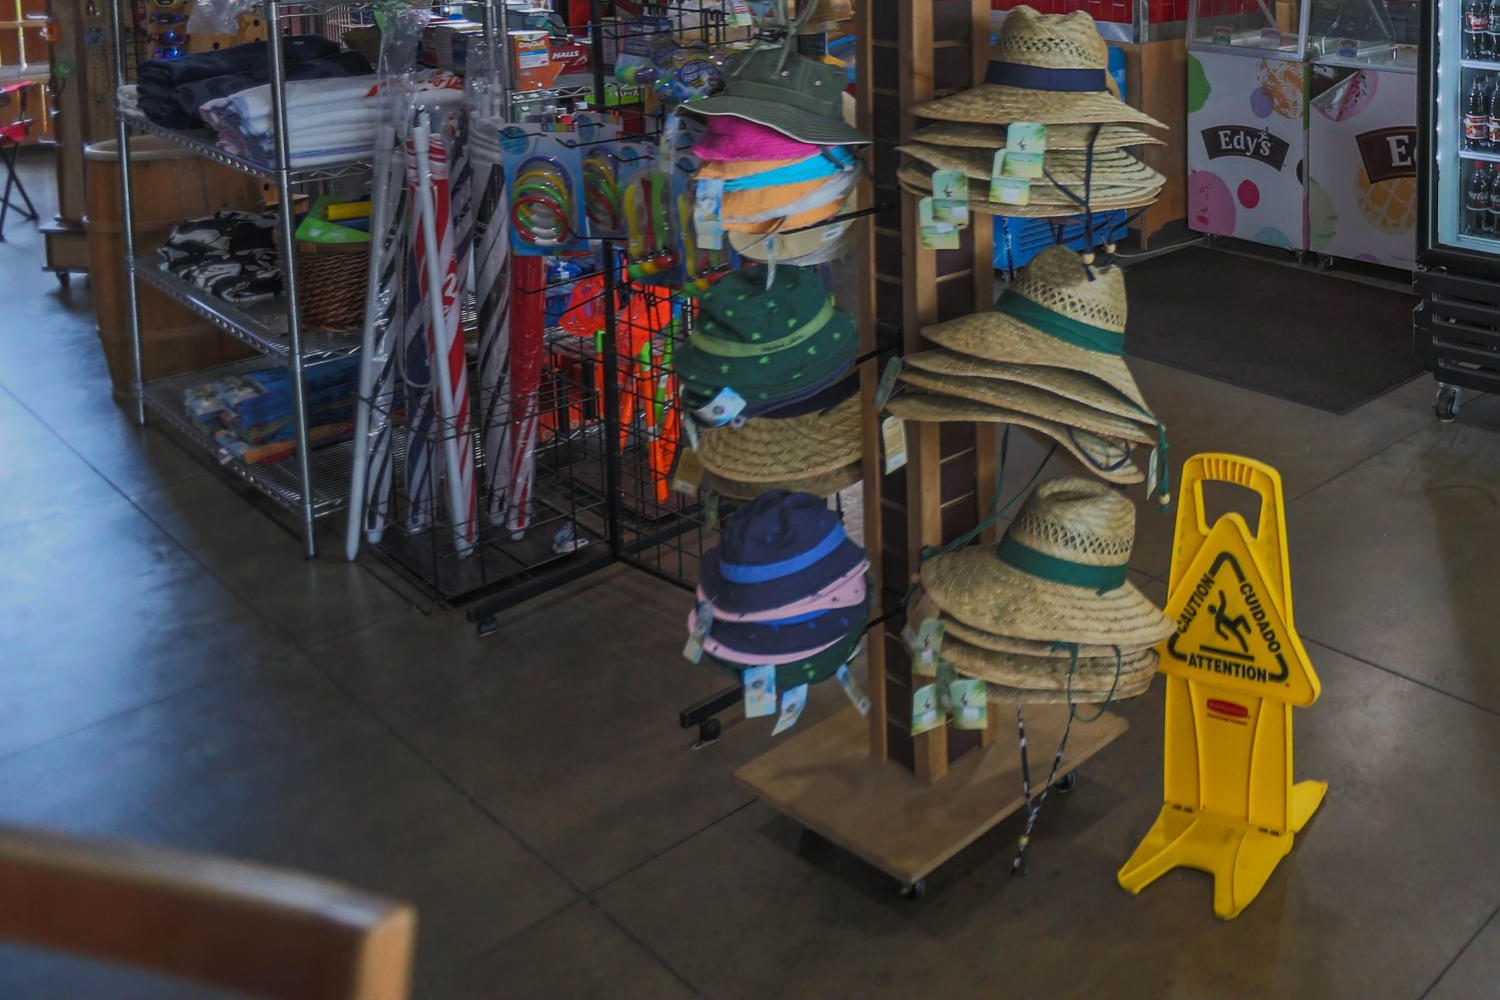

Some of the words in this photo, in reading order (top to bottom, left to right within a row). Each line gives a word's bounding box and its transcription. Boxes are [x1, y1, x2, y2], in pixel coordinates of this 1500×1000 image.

[551, 50, 580, 60] HALLS
[1218, 127, 1272, 157] Edy's
[1176, 572, 1216, 635] CAUTION
[1239, 582, 1282, 654] CUIDADO
[1187, 654, 1269, 684] ATTENTION
